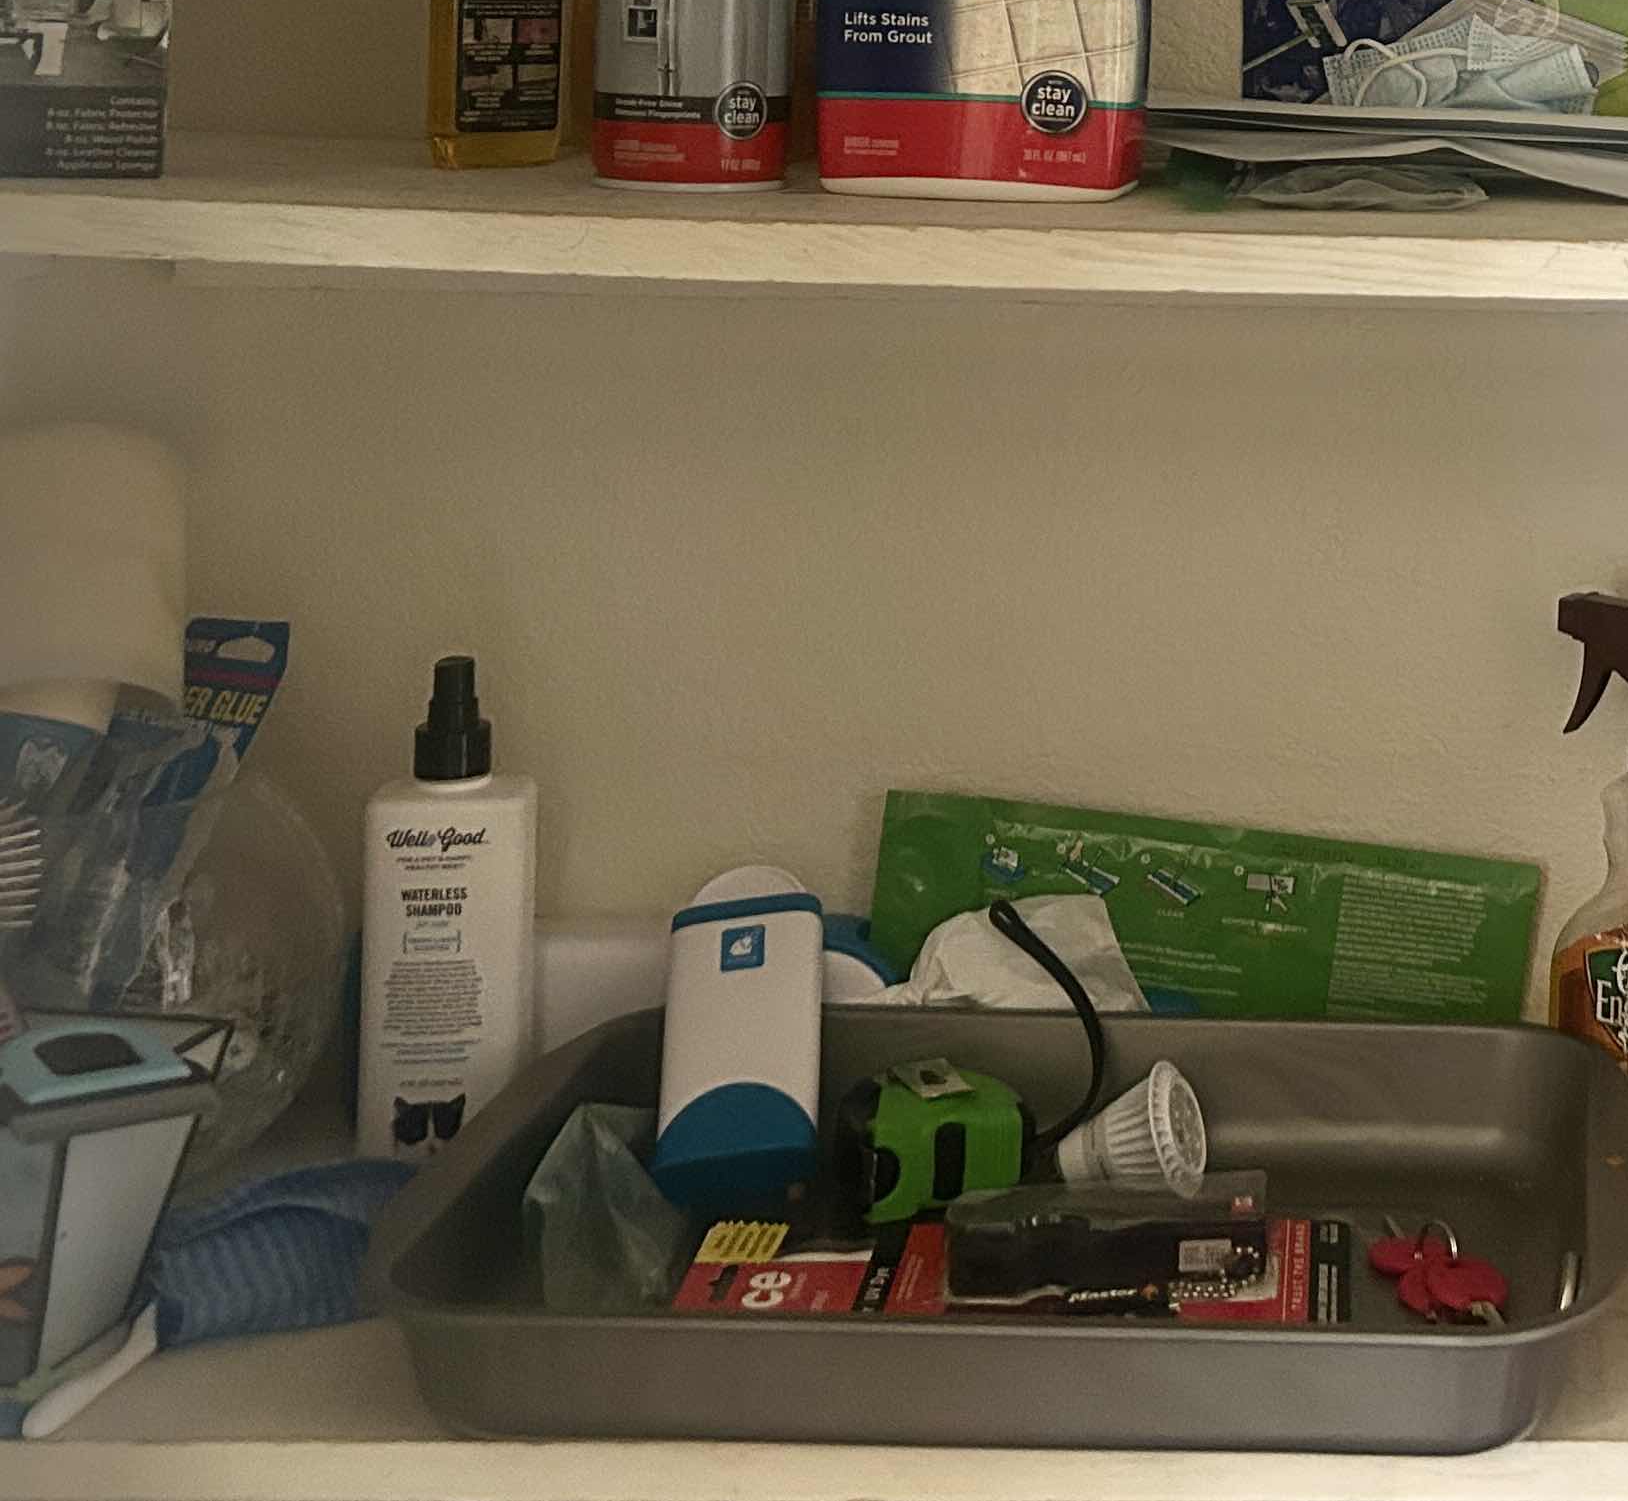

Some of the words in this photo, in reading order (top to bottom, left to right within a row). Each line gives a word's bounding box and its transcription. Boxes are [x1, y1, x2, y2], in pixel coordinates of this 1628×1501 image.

[844, 11, 877, 26] Lifts
[881, 12, 929, 28] Stains
[844, 29, 883, 44] From
[887, 30, 933, 45] Grout
[1036, 84, 1072, 105] stay
[729, 96, 757, 114] stay
[1031, 101, 1075, 118] clean
[724, 112, 760, 125] clean
[400, 887, 467, 901] WATERLESS
[405, 902, 462, 917] SHAMPOO
